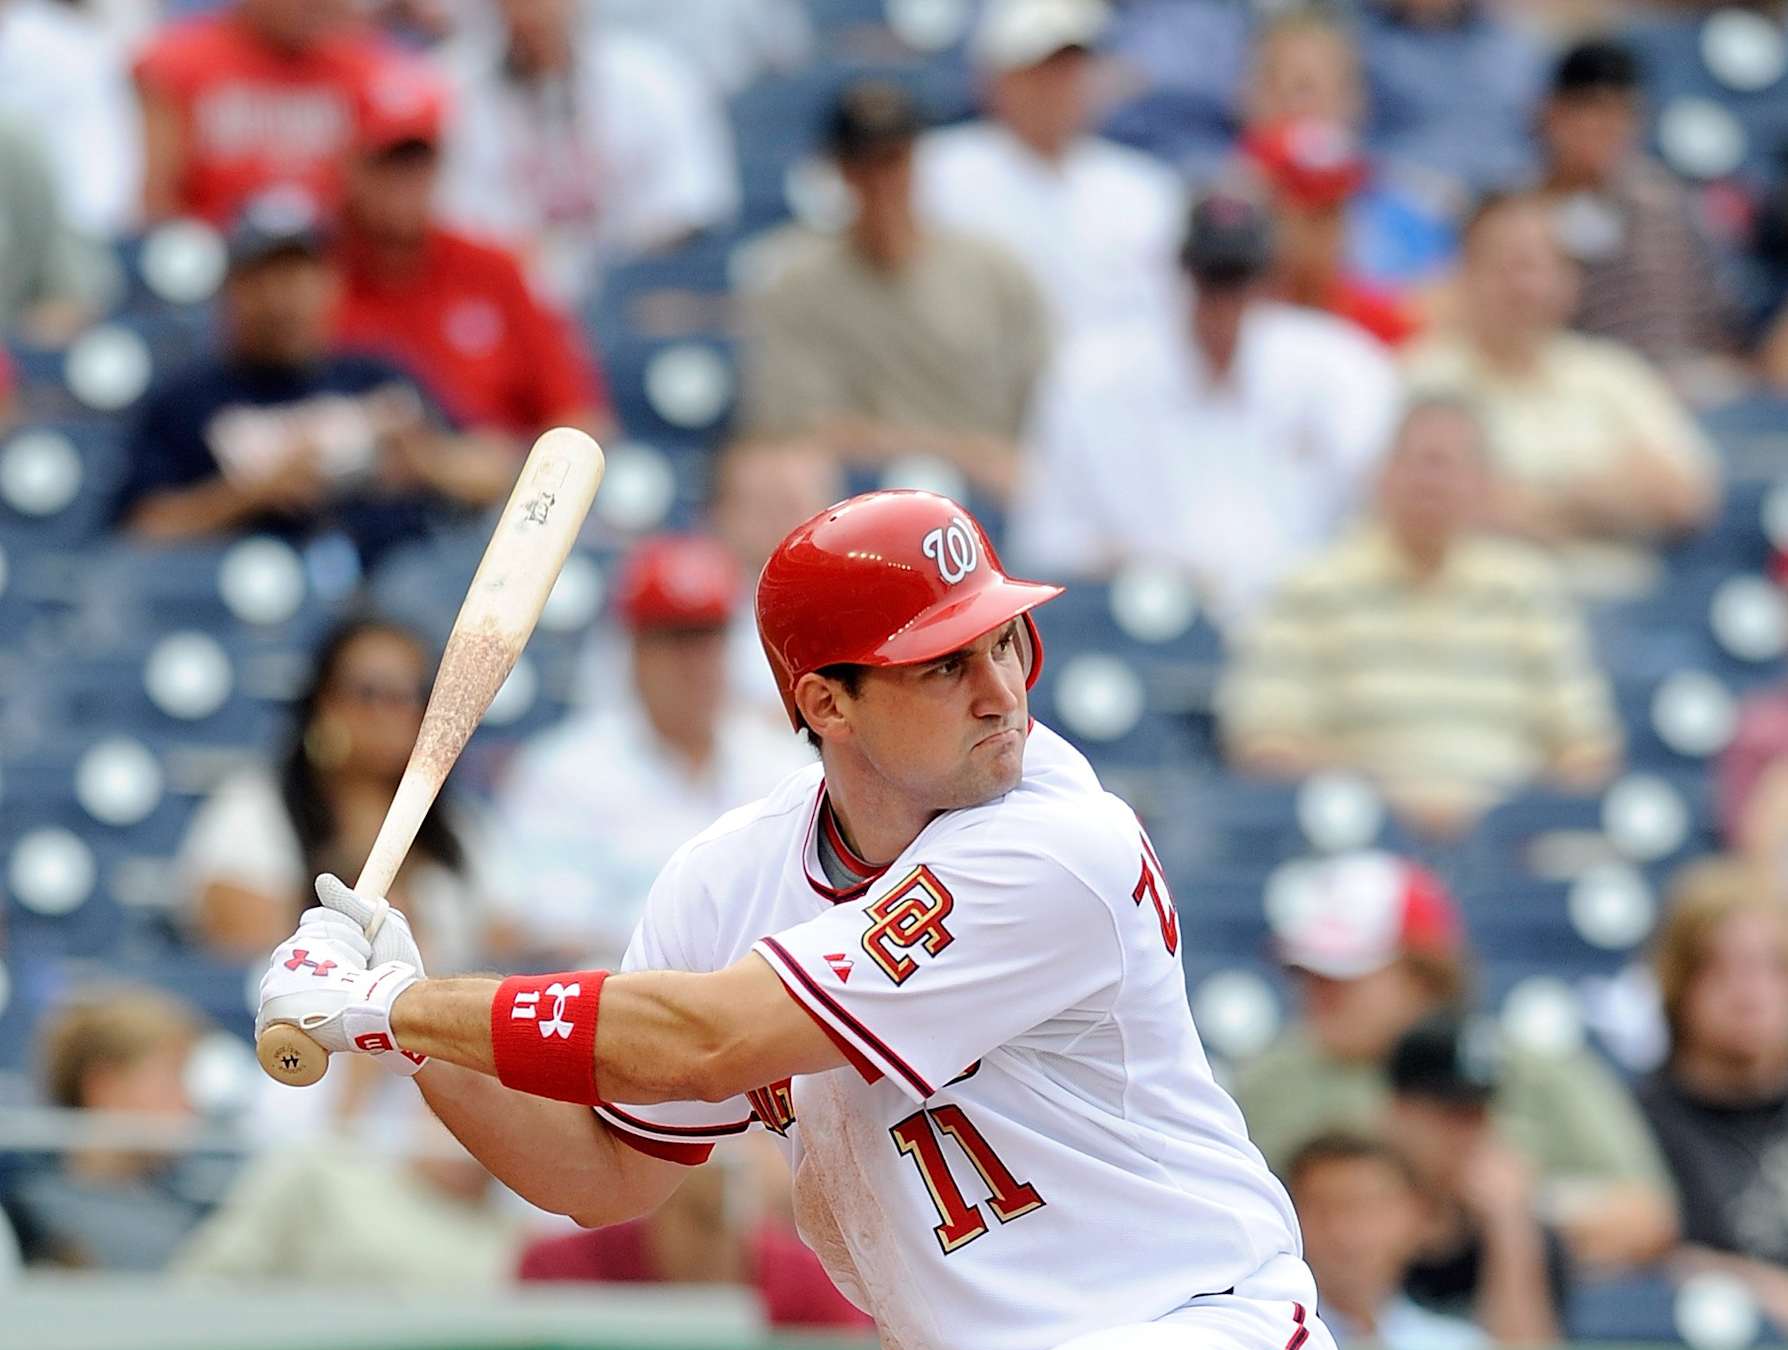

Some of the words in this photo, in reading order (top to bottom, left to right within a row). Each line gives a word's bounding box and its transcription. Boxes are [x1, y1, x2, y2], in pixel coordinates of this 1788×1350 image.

[922, 516, 978, 585] W
[510, 989, 541, 1020] 11
[889, 1102, 1048, 1257] 11
